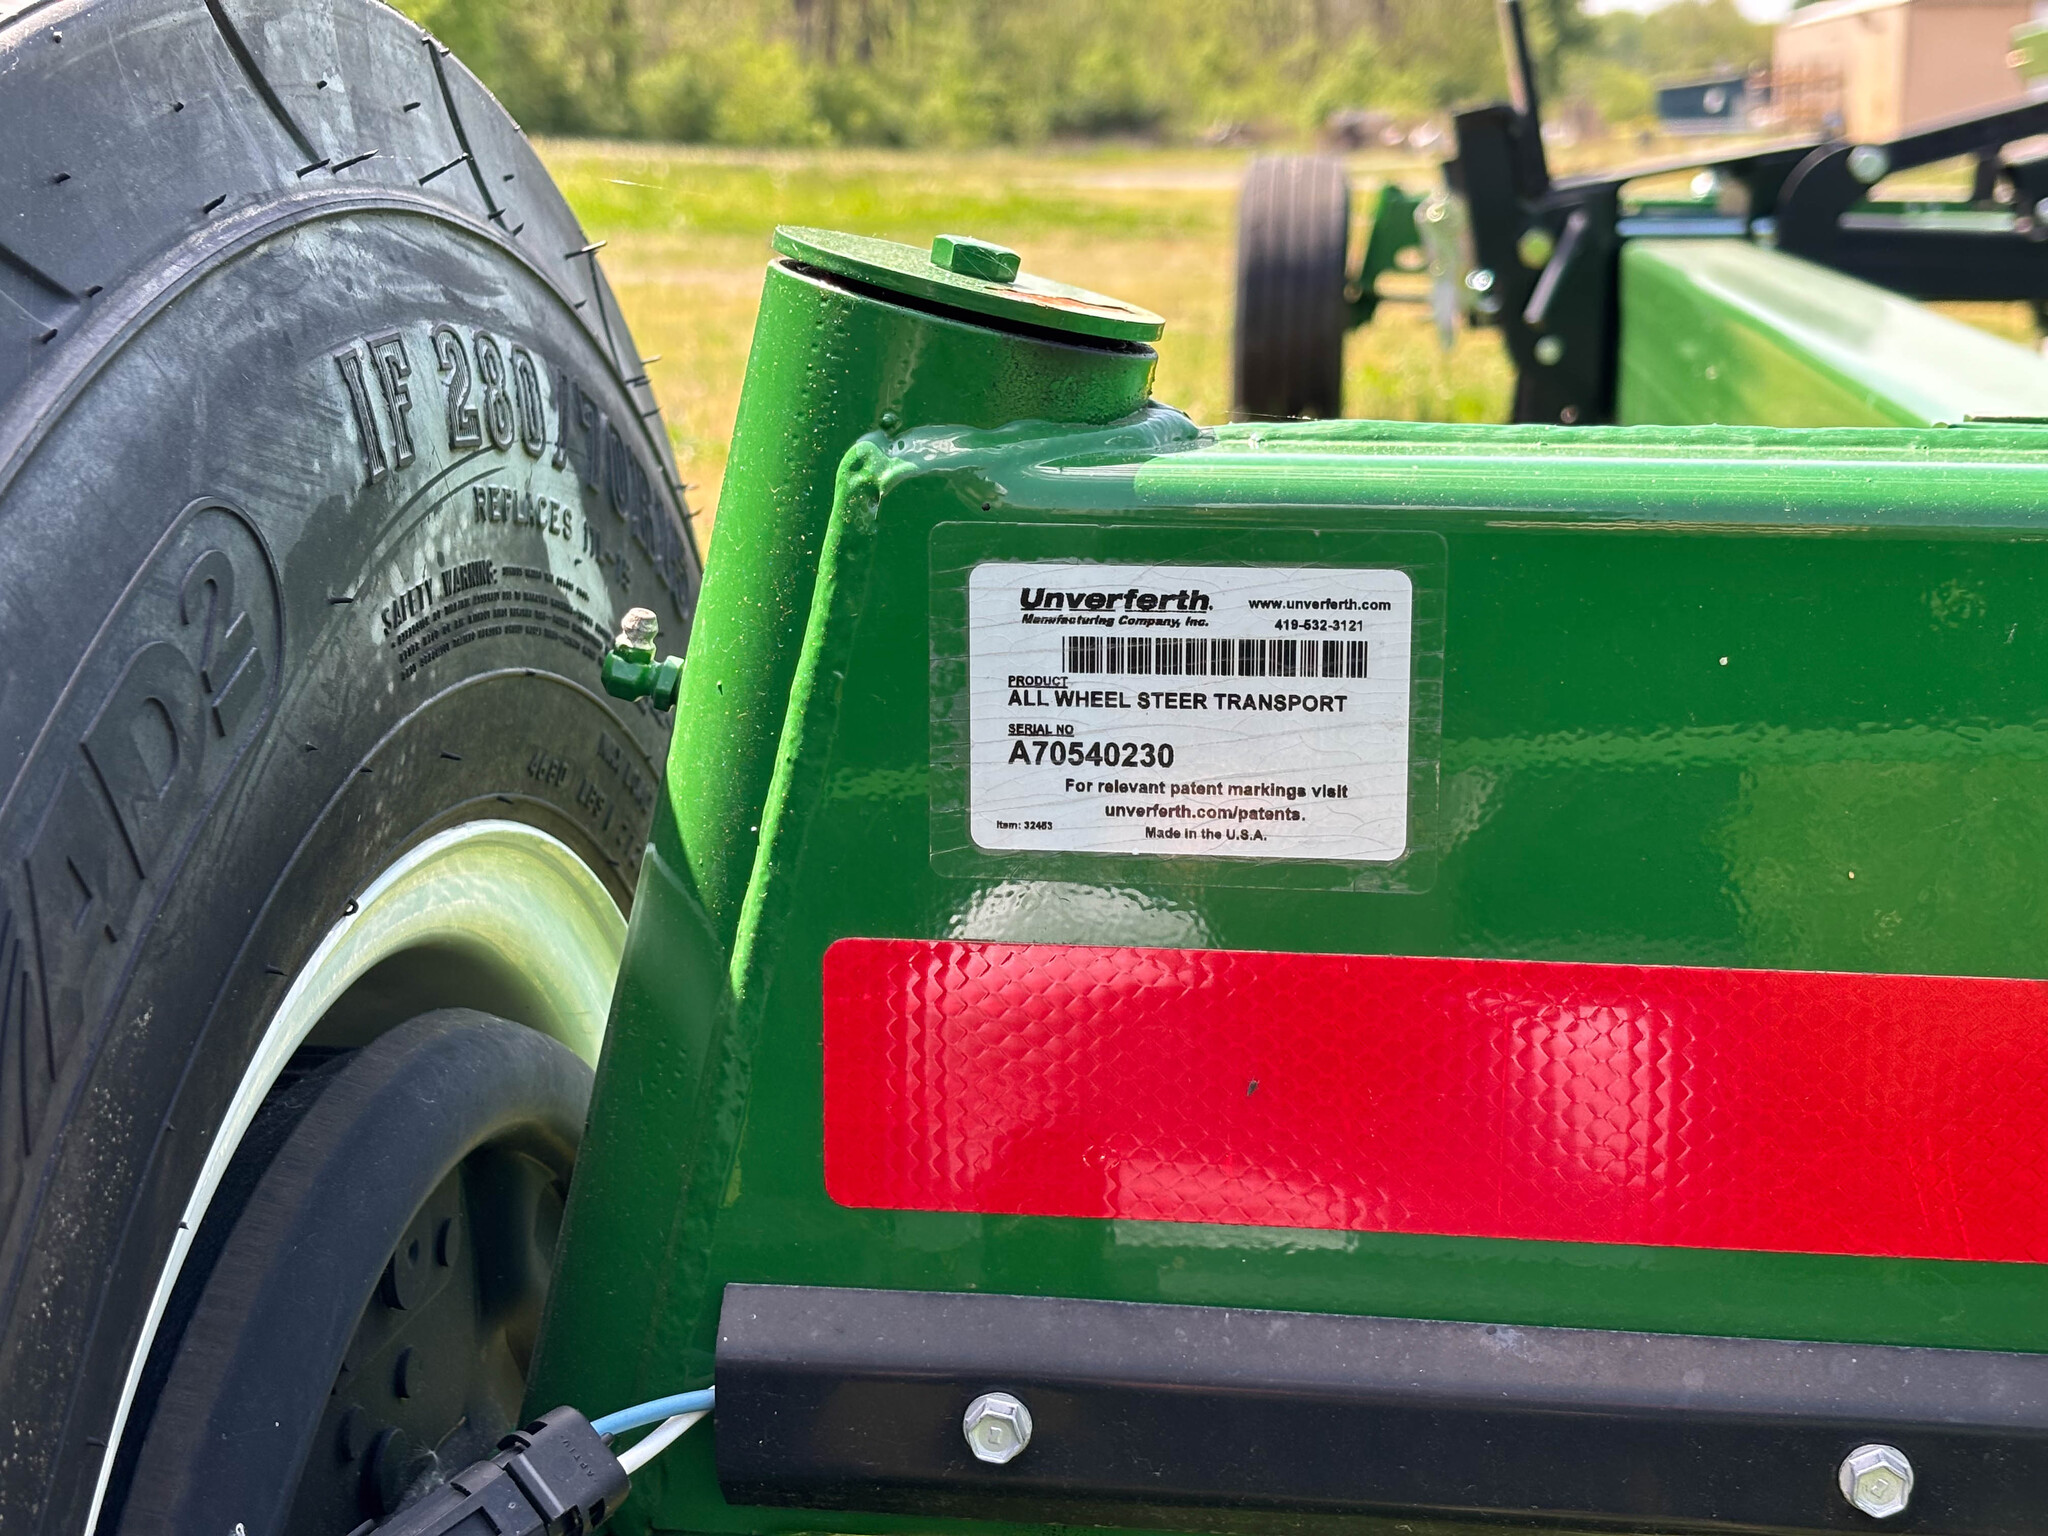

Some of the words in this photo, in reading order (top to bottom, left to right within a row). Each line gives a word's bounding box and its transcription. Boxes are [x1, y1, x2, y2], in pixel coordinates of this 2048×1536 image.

[334, 326, 416, 486] IF
[472, 484, 573, 542] REPLACES
[380, 577, 434, 637] SAFETY
[1248, 598, 1391, 611] www.unverferth.com
[1022, 613, 1115, 627] Manufacturing
[1118, 615, 1182, 629] Company,
[1185, 617, 1210, 627] Inc.
[1274, 619, 1363, 632] 419-532-3121
[1008, 675, 1068, 688] PRODUCT
[1008, 690, 1050, 707] ALL
[1054, 691, 1131, 708] WHEEL
[1137, 692, 1208, 710] STEER
[1213, 693, 1348, 712] TRANSPORT
[1008, 724, 1053, 735] SERIAL
[1056, 724, 1075, 735] NO
[1008, 739, 1175, 769] A70540230
[1065, 778, 1093, 793] For
[1098, 779, 1166, 794] relevant
[1170, 781, 1224, 798] patent
[1228, 783, 1307, 801] markings
[1311, 784, 1349, 799] visit
[1105, 804, 1306, 823] unverferth.com/patents.
[996, 820, 1022, 830] Item:
[1145, 826, 1181, 839] Made
[1184, 828, 1197, 839] in
[1201, 828, 1222, 840] the
[1225, 829, 1268, 841] U.S.A.
[561, 1439, 596, 1478] APTIV
